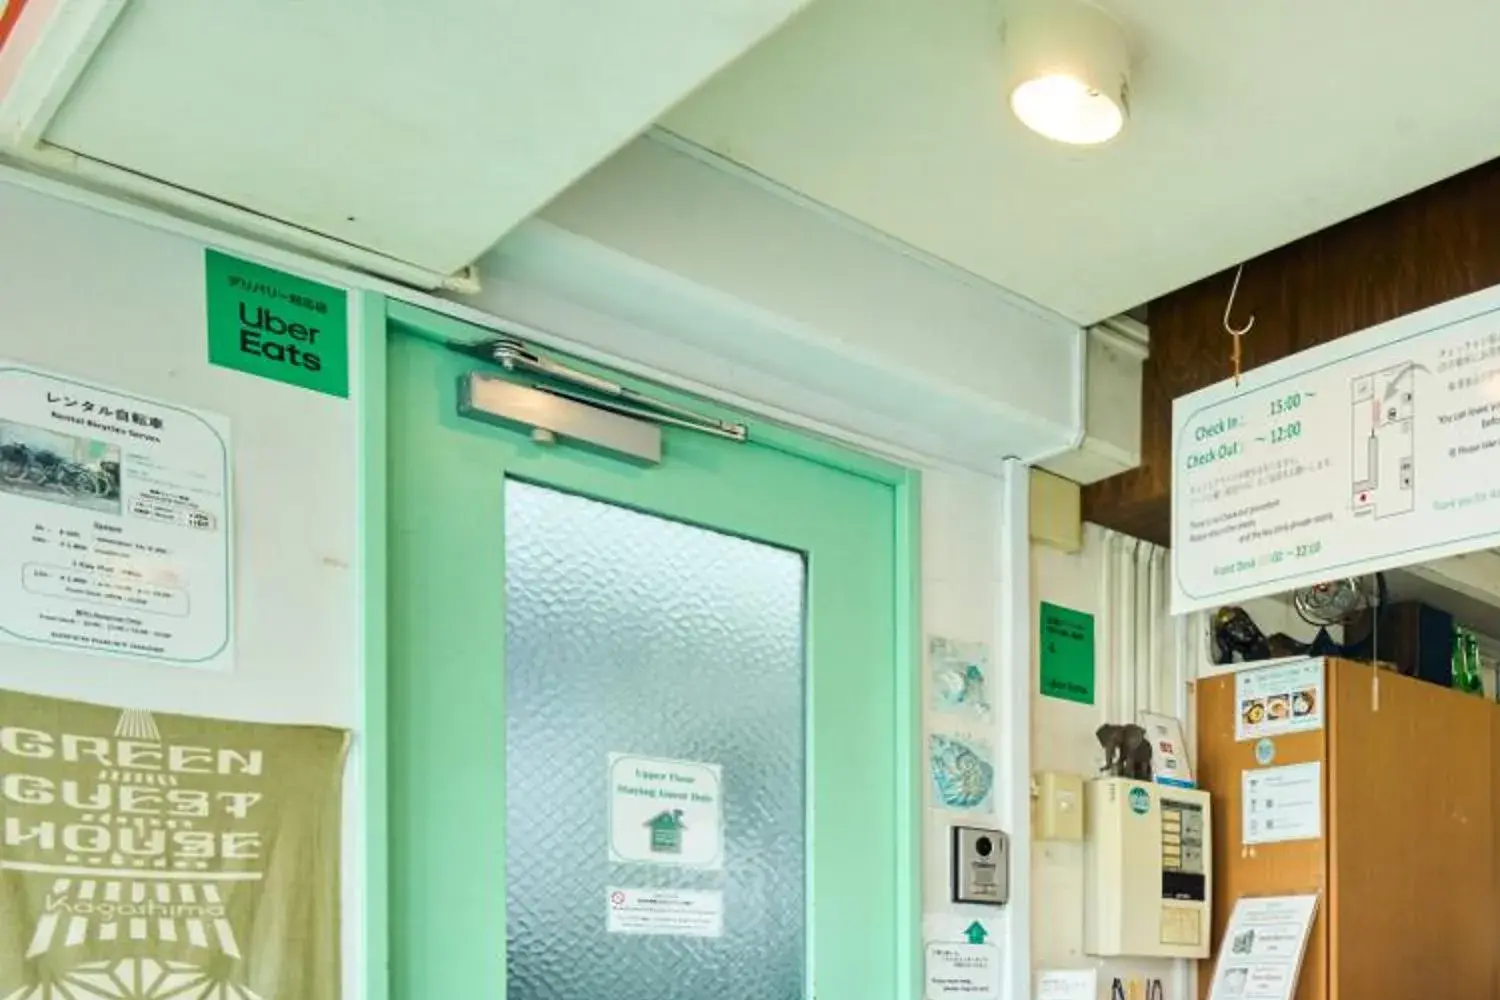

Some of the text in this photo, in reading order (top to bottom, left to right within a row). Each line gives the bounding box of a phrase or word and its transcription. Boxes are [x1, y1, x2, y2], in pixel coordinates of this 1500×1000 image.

[239, 301, 320, 344] Uber
[240, 328, 321, 371] Eats
[46, 391, 164, 431] レンタル自転車
[1268, 392, 1301, 417] 15:00
[1194, 415, 1239, 443] Check In
[1270, 421, 1301, 445] 12:00
[1186, 441, 1238, 470] Check Out
[0, 727, 263, 776] GREEN
[2, 774, 263, 819] GUEST
[3, 817, 262, 859] HOUSE
